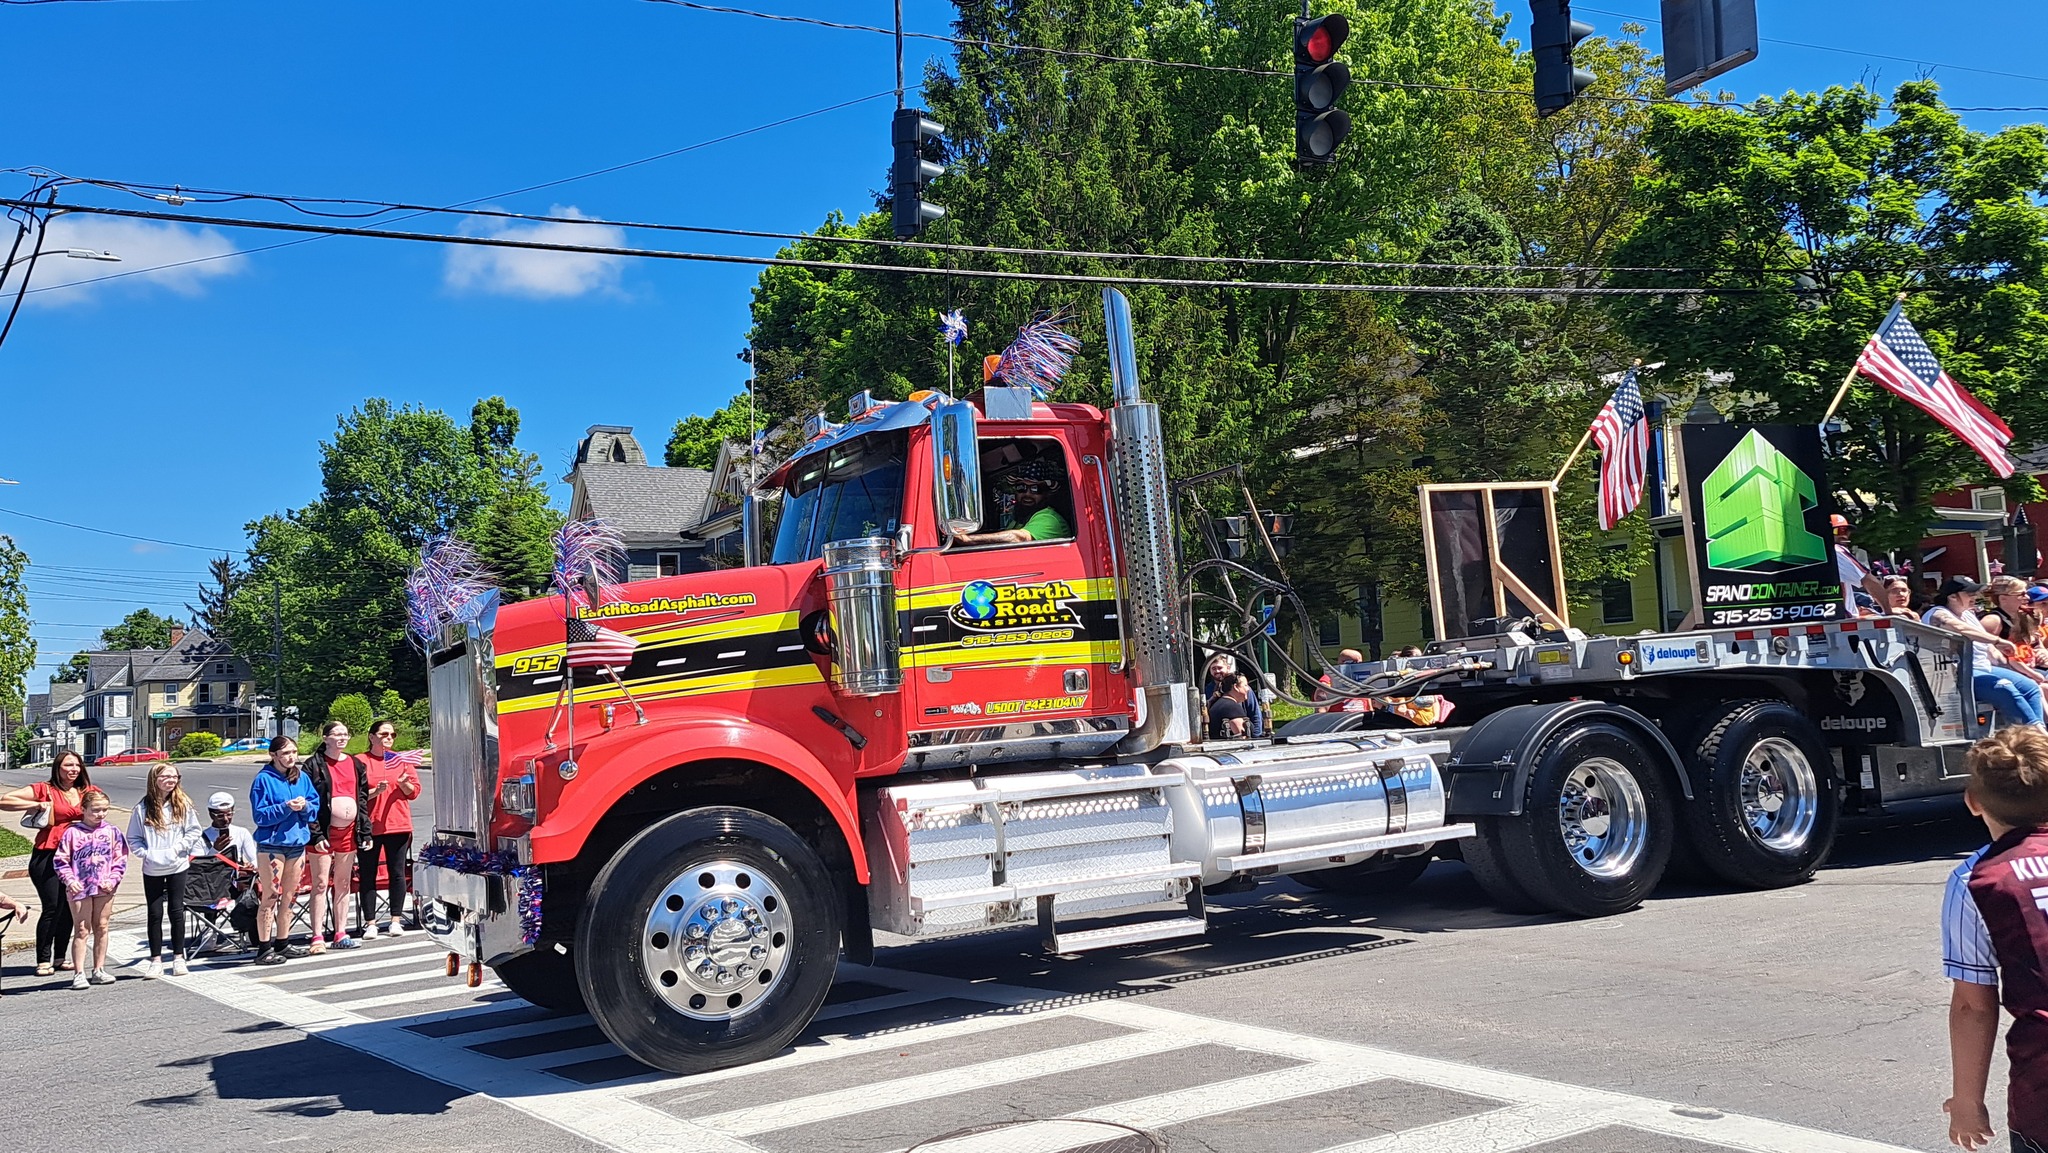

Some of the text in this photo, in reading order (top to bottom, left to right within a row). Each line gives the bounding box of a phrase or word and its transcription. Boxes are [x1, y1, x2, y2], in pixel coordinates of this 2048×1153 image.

[996, 582, 1072, 601] Earth
[1706, 581, 1840, 602] SPANDCONTAINER.COM
[578, 593, 754, 619] EarthRoadAsphalt.com
[995, 601, 1057, 618] Road
[1712, 603, 1836, 625] 315-253-9062
[980, 614, 1072, 627] ASPHALT
[962, 629, 1073, 646] 315-253-0203
[1657, 647, 1696, 660] deloupe
[514, 655, 560, 674] 952
[986, 701, 1022, 714] USDOT
[1821, 715, 1887, 732] deloupe
[2009, 856, 2048, 881] KU
